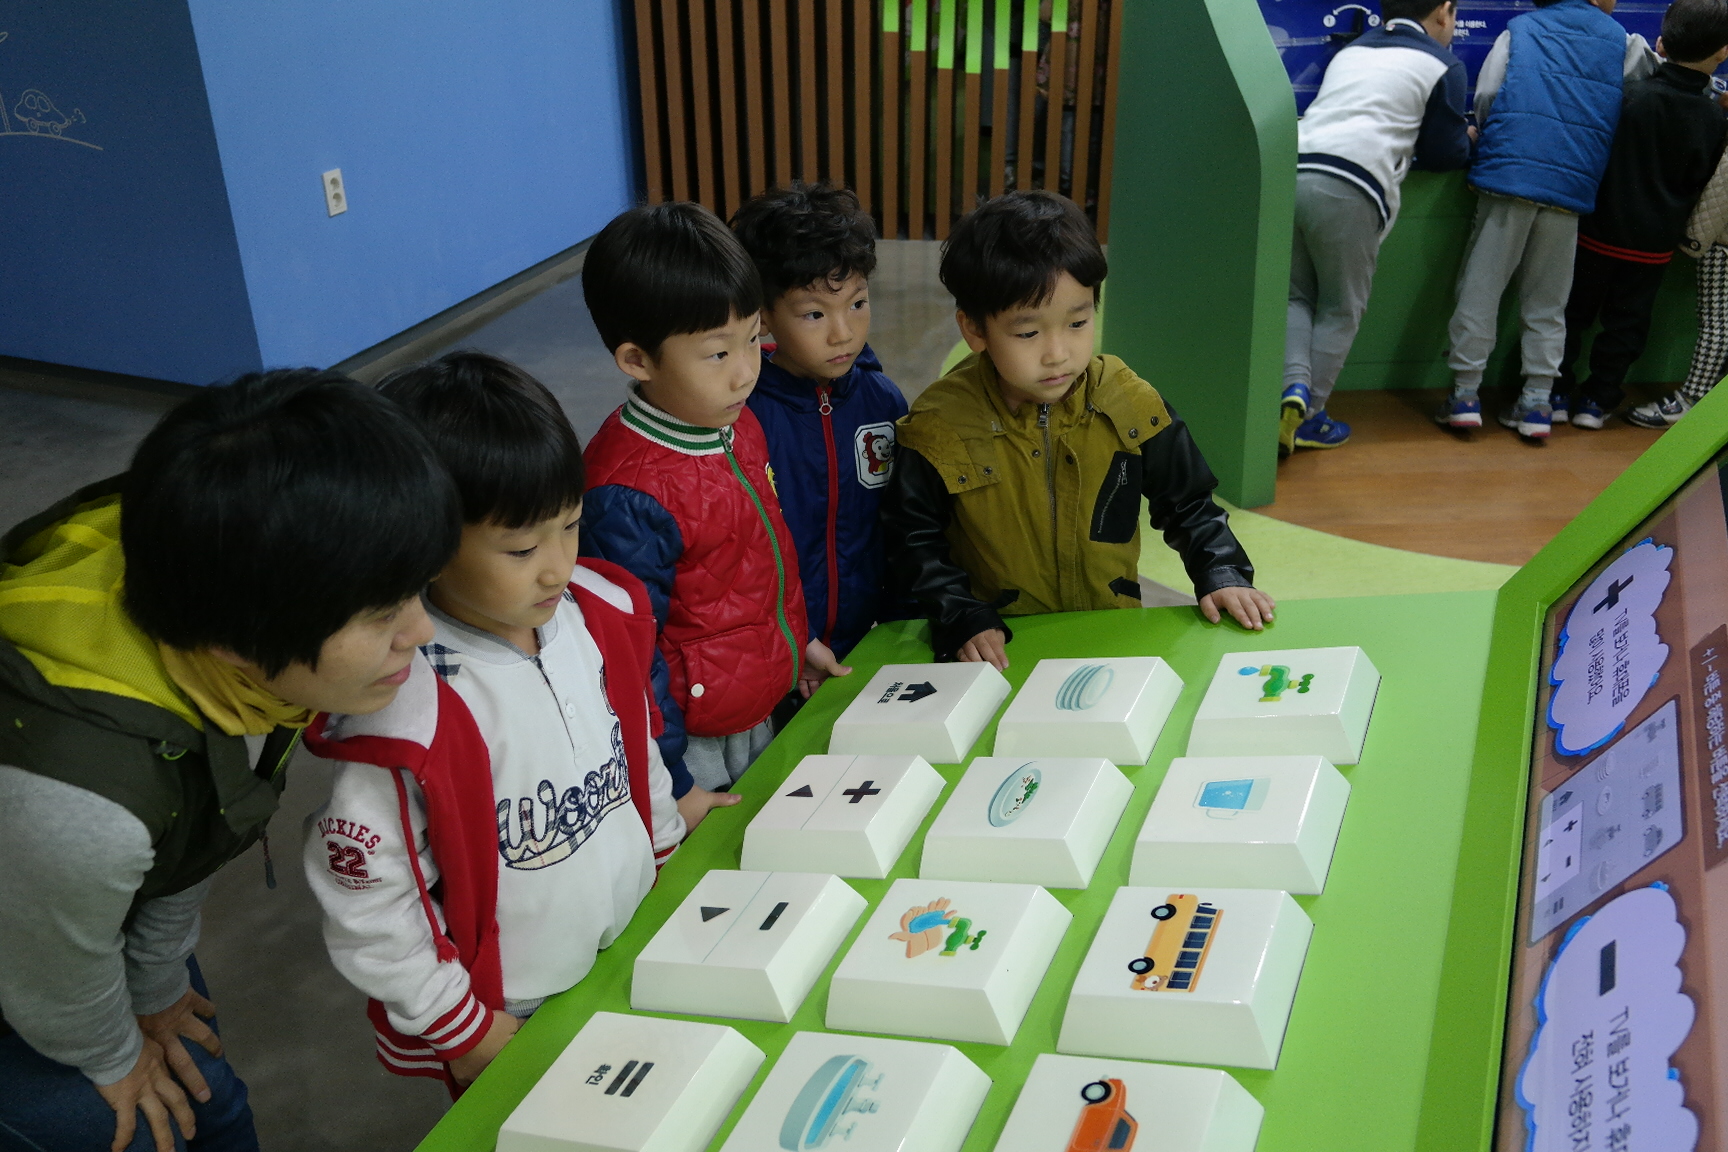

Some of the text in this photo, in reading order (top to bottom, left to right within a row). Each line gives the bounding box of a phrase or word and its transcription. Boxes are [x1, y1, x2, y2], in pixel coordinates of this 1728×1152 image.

[1586, 627, 1605, 705] 많이 사용했어요.
[1612, 607, 1630, 708] TV를 보거나 휴대폰을
[1703, 670, 1721, 696] 버튼
[317, 817, 382, 849] DICKIES
[326, 840, 370, 879] 22
[1571, 1029, 1595, 1075] 전혀
[585, 1063, 612, 1086] 확인
[1605, 1005, 1632, 1152] TV를 보거나 휴
